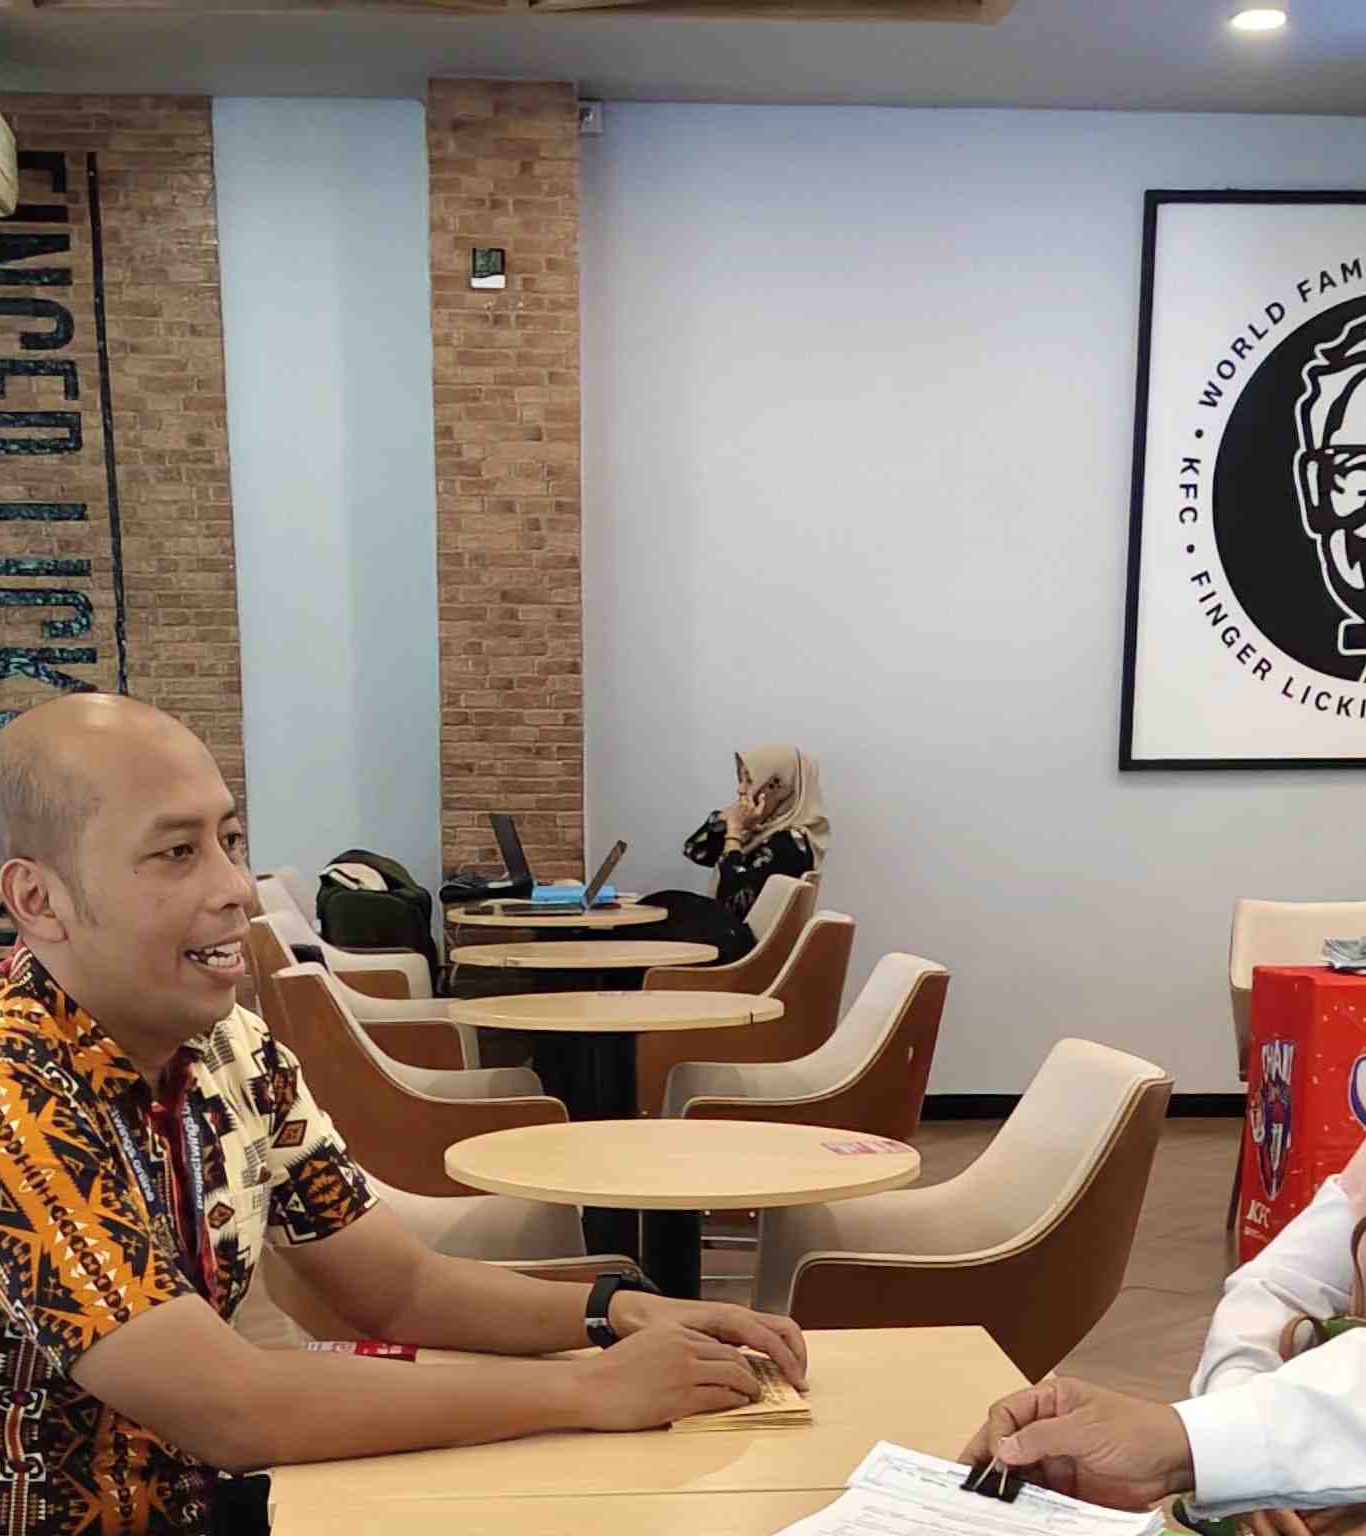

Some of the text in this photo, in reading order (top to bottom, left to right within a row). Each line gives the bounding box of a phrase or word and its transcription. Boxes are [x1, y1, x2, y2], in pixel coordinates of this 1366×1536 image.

[1198, 301, 1286, 410] WORLD
[1178, 457, 1202, 525] KFC
[1190, 569, 1273, 682] FINGER
